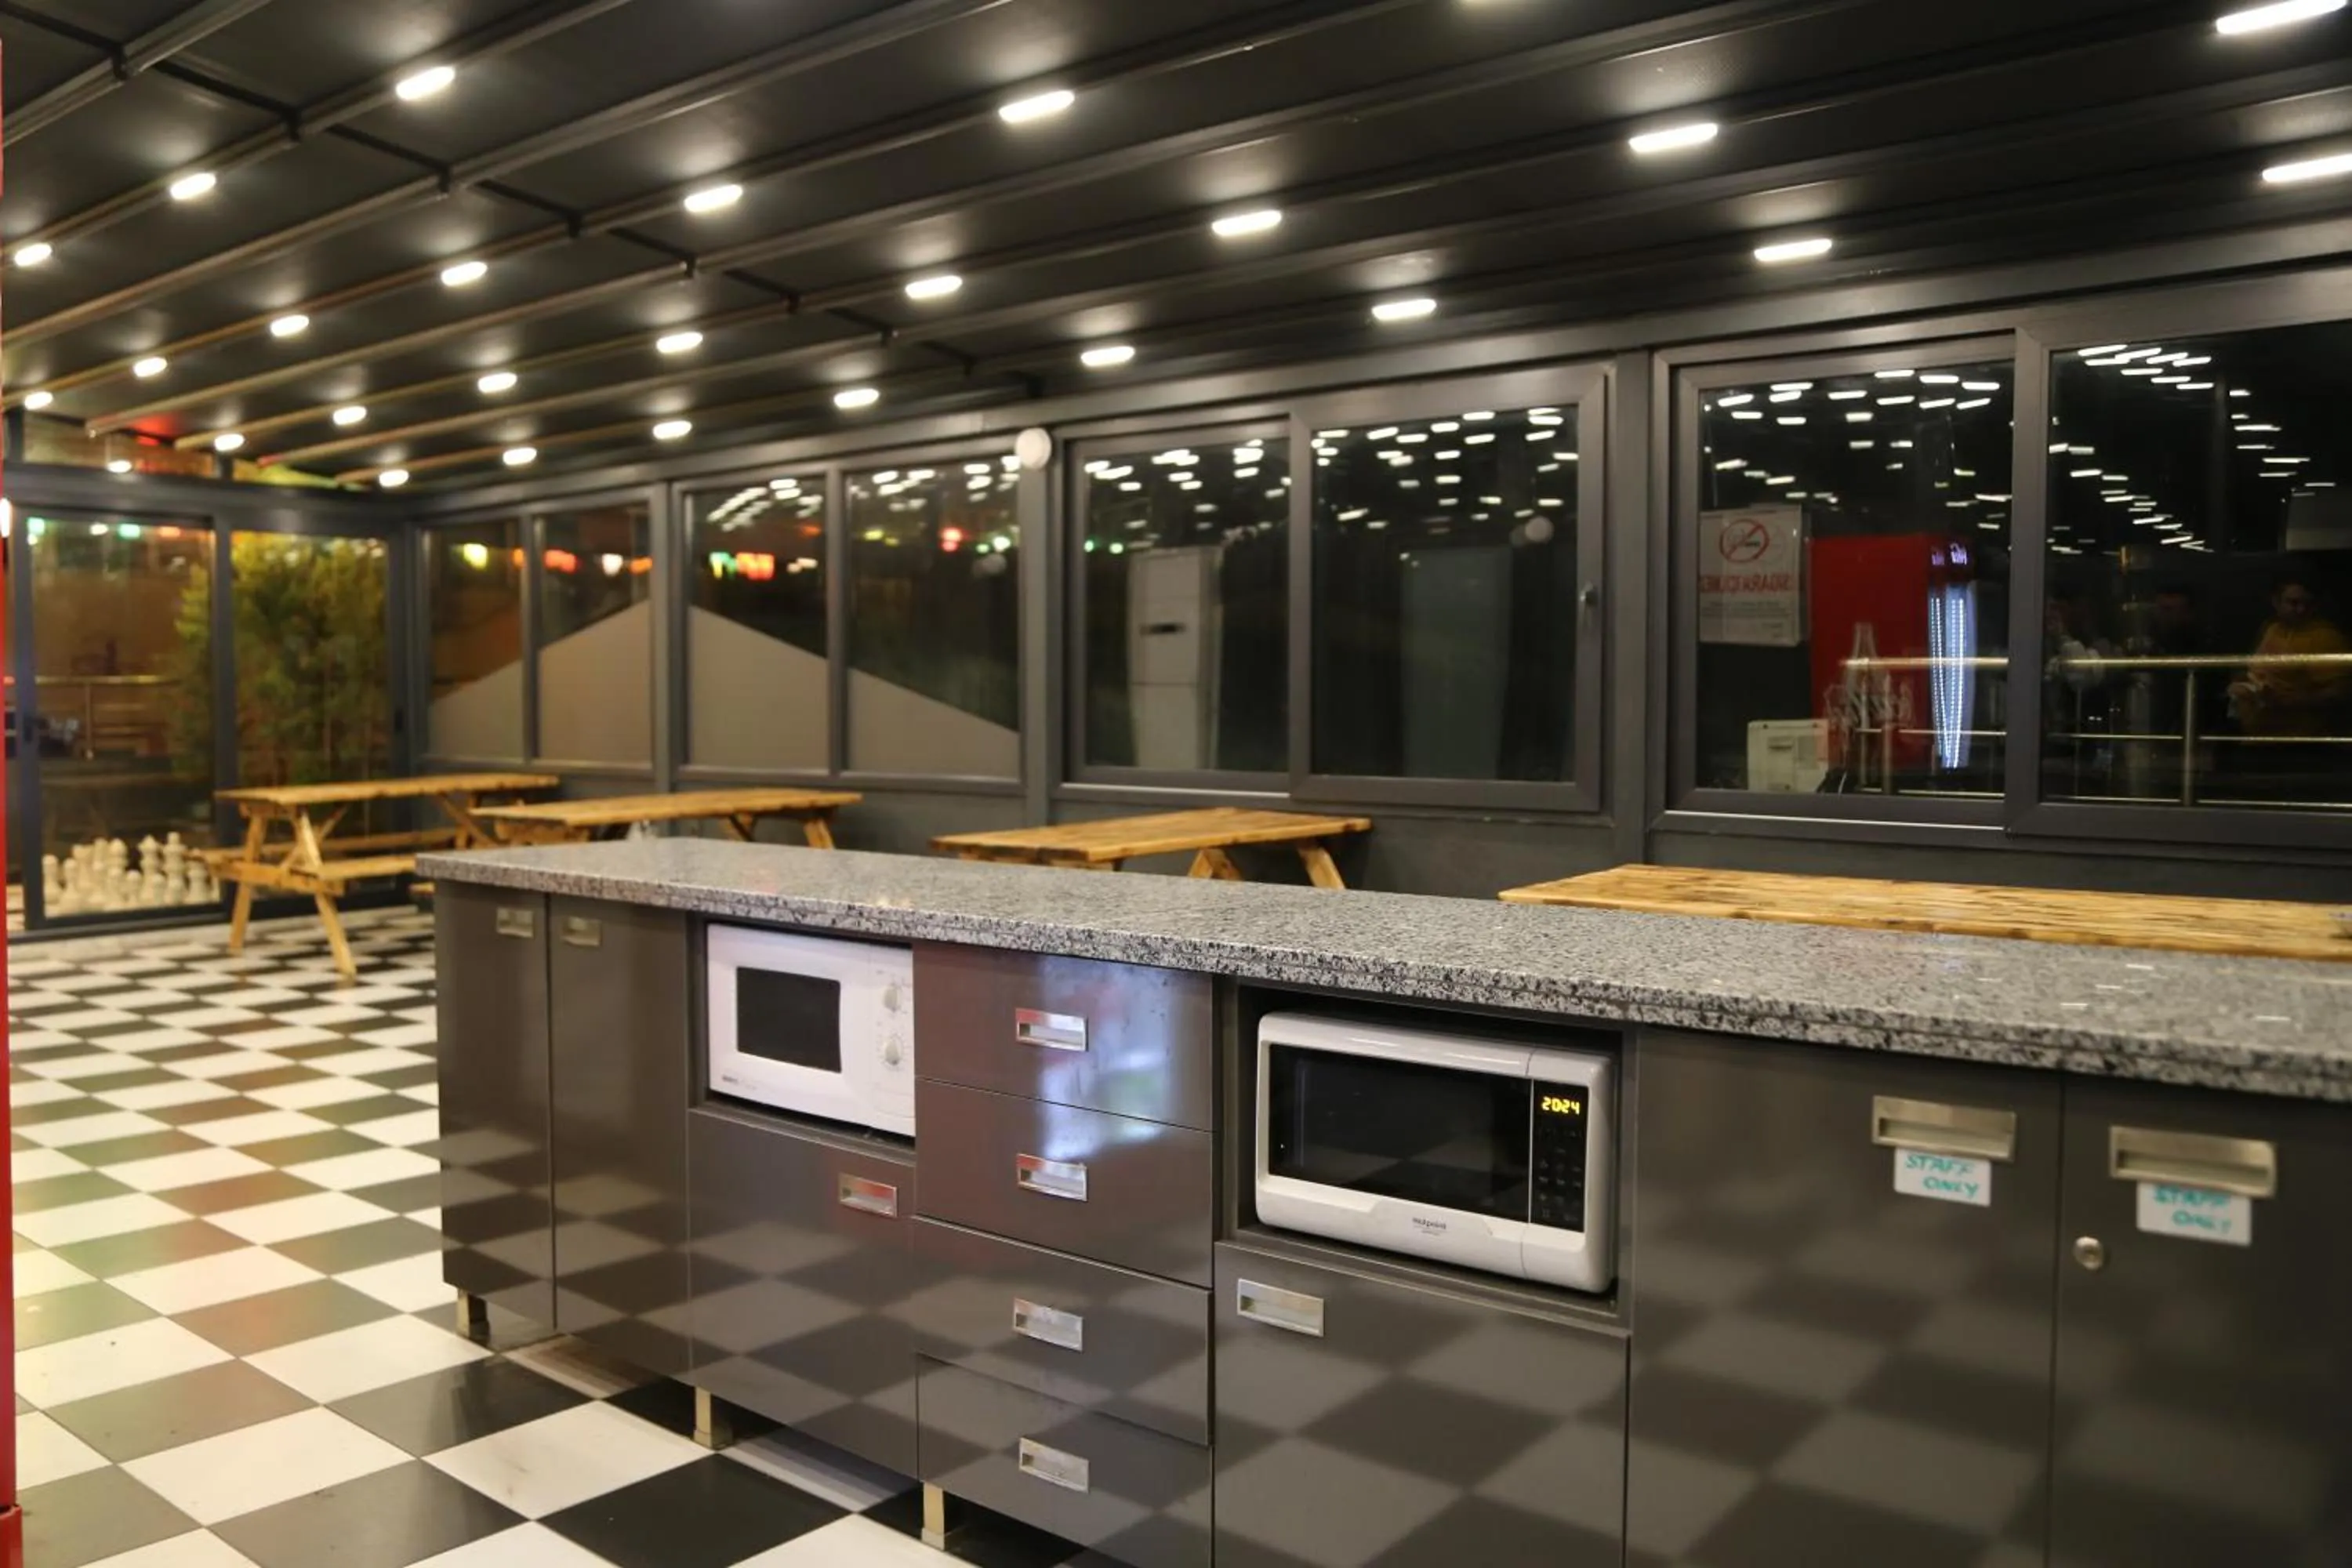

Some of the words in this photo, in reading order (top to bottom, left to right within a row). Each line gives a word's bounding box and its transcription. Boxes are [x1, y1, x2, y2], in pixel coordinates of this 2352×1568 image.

[1541, 1096, 1580, 1114] 2024
[1905, 1153, 1974, 1174] STAFF
[1922, 1176, 1980, 1199] ONLY
